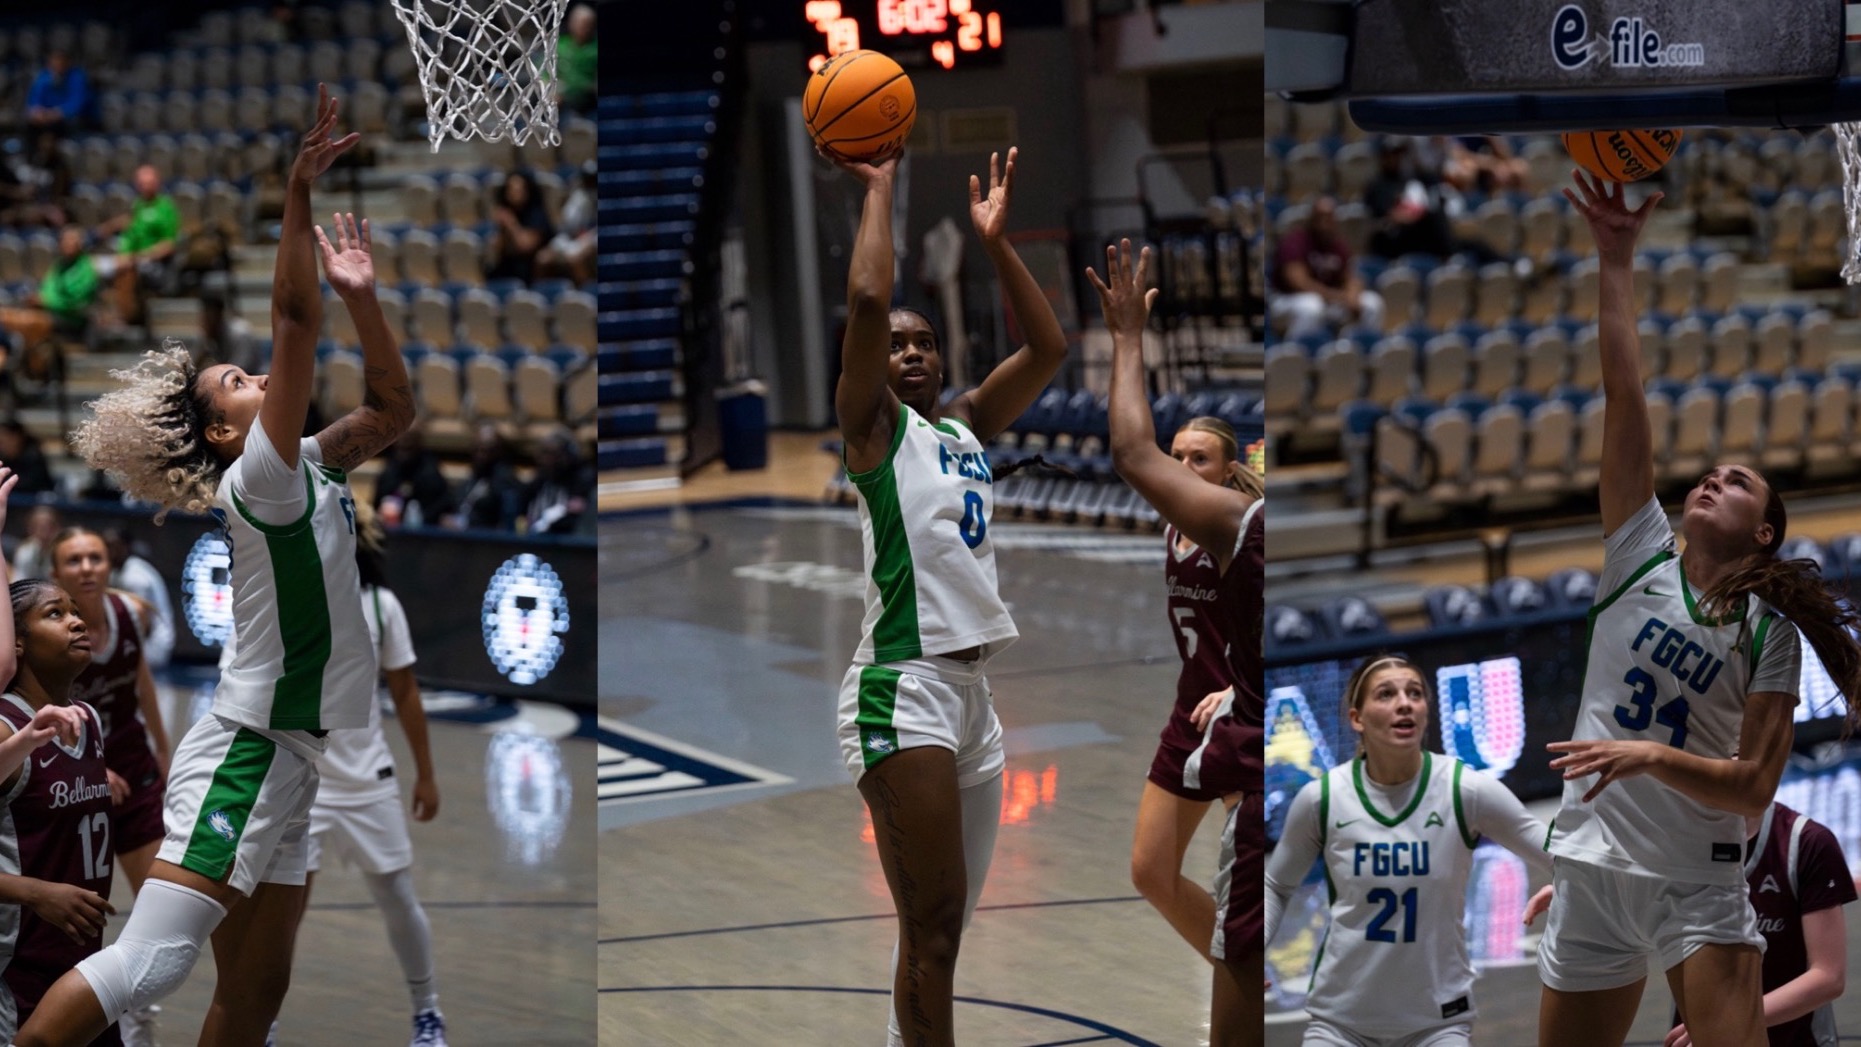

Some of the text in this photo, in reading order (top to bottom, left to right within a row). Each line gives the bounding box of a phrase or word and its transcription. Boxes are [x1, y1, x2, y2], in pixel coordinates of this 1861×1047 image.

[958, 11, 1002, 51] 21
[960, 489, 986, 550] 0
[1172, 607, 1199, 659] 5
[1631, 616, 1725, 695] FGCU
[1613, 666, 1691, 750] 34
[77, 811, 111, 881] 12
[1353, 840, 1430, 877] FGCU
[1365, 886, 1418, 943] 21
